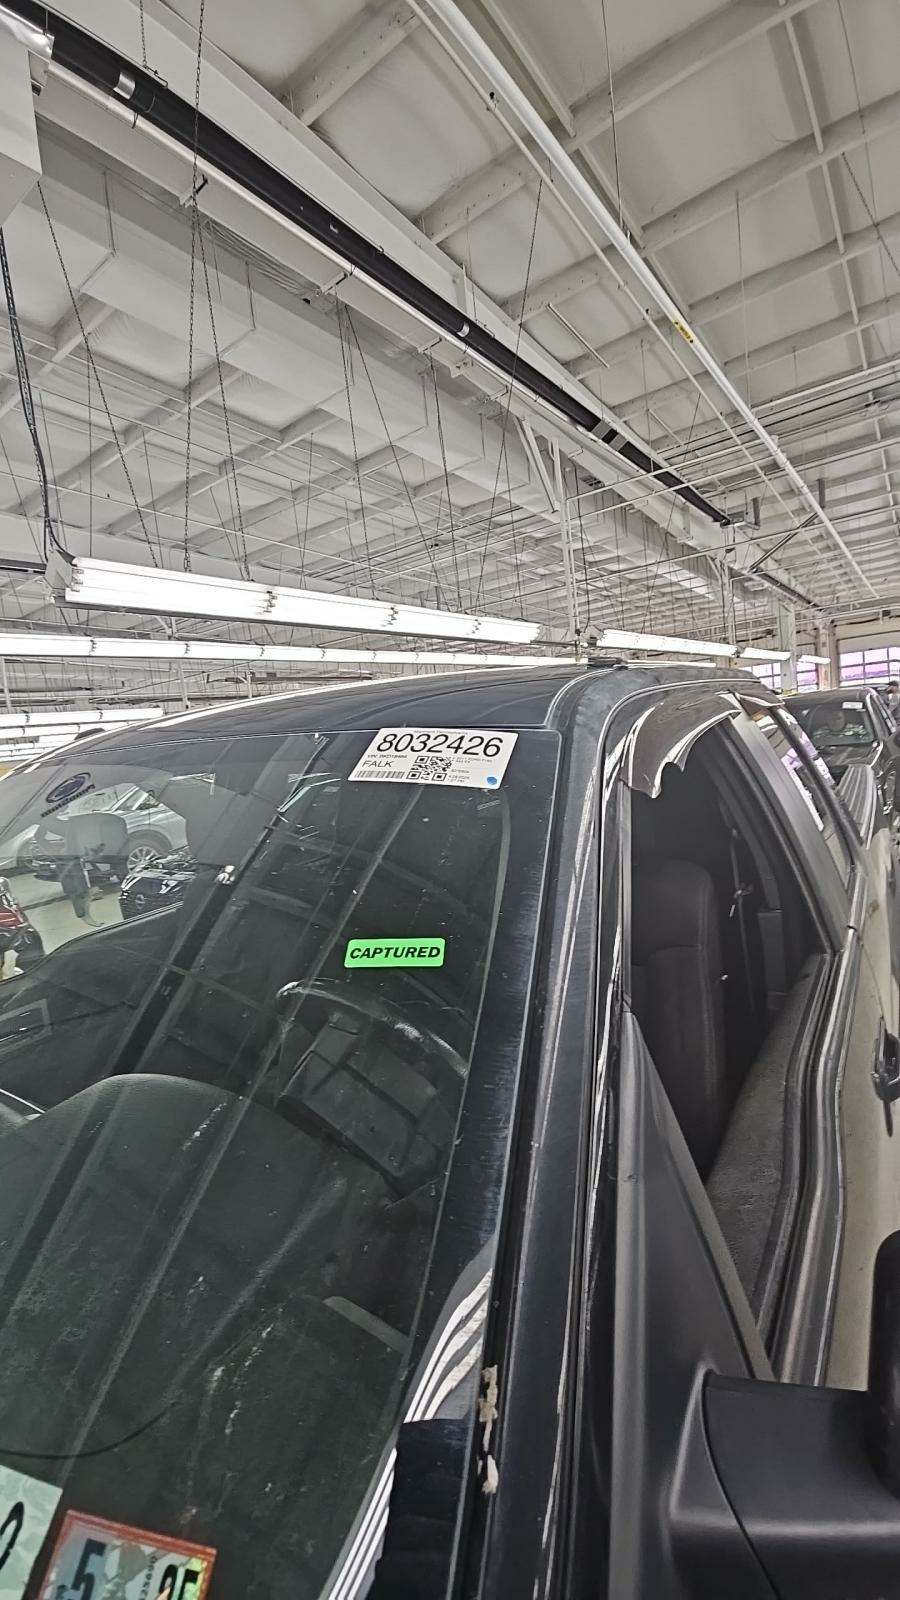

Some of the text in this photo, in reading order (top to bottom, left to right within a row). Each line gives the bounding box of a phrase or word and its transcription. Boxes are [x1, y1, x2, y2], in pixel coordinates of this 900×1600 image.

[376, 733, 504, 757] 8032426
[361, 760, 395, 768] FALK
[349, 946, 441, 959] CAPTURED
